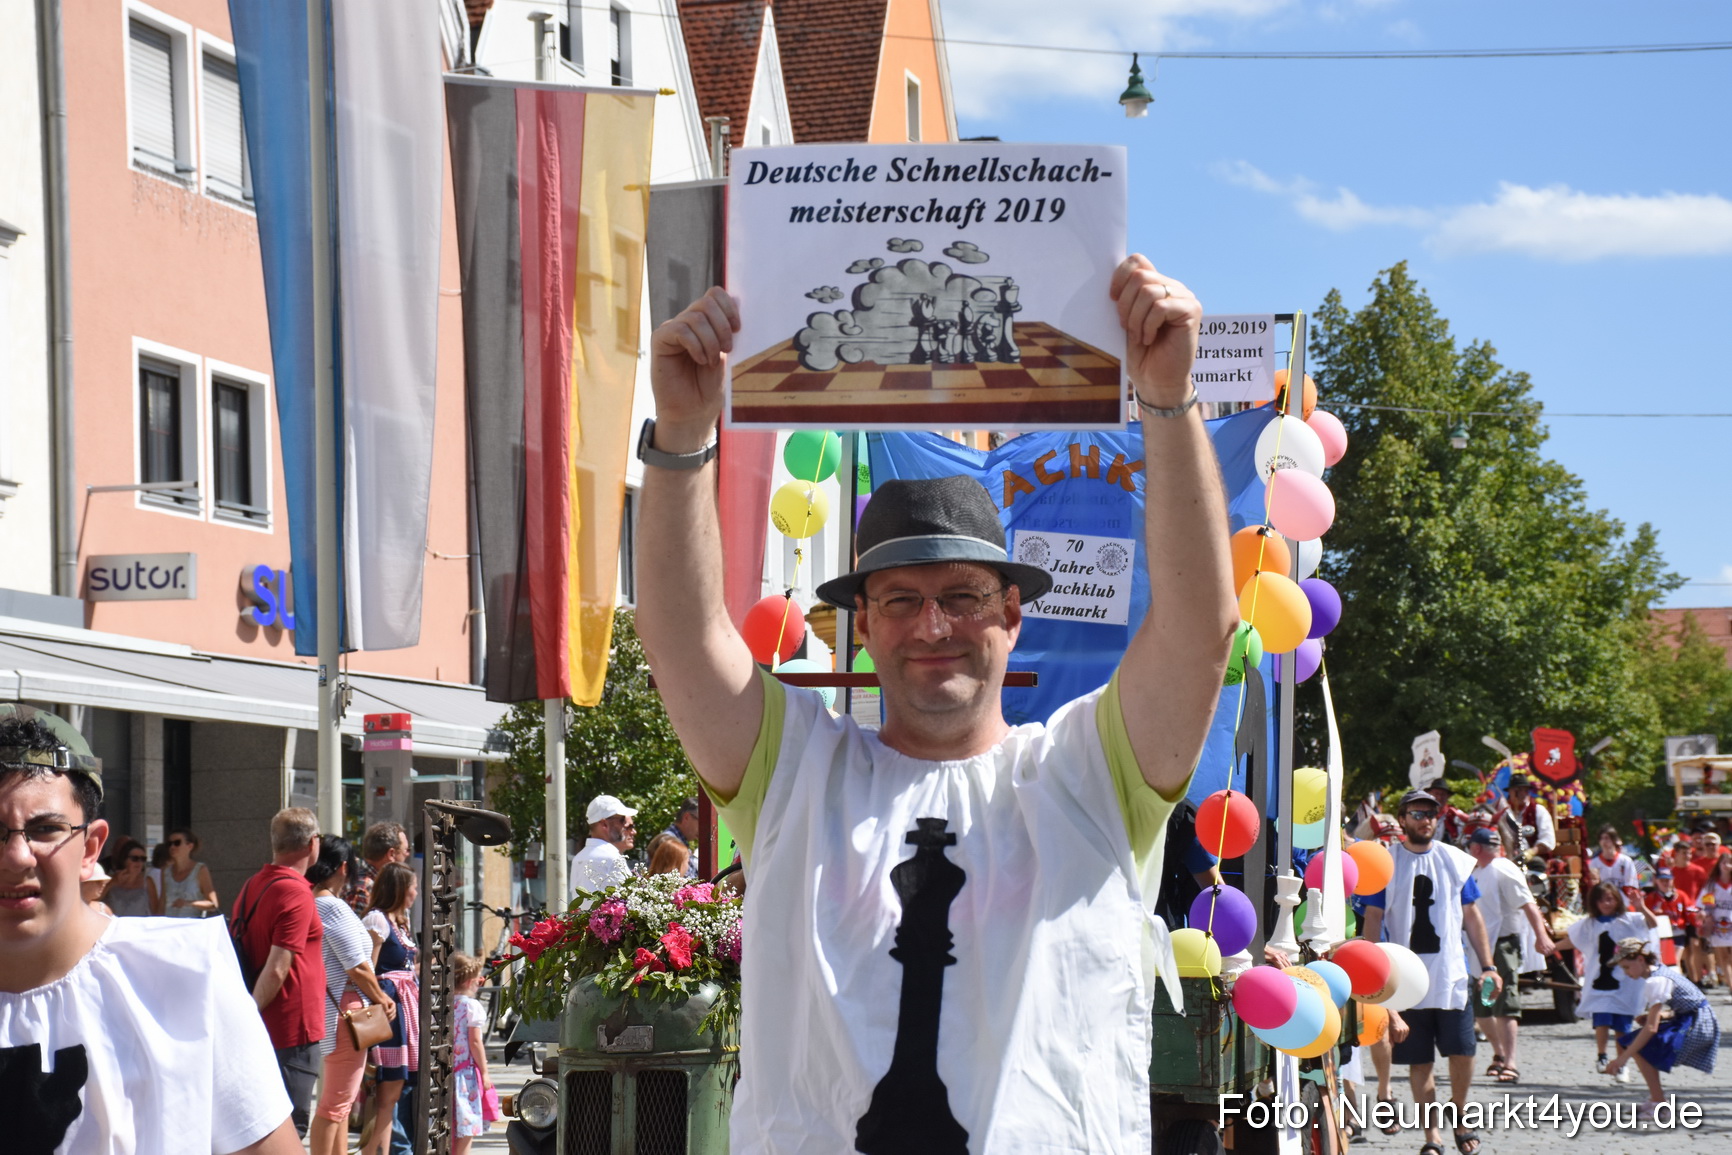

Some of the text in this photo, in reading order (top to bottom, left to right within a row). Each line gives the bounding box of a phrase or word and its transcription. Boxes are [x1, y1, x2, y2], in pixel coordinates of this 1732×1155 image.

[744, 157, 1112, 185] Deutsche Schnellschach-
[788, 197, 1066, 230] meisterschaft 2019
[1066, 539, 1084, 553] 70
[1050, 559, 1095, 576] Jahre
[1048, 582, 1116, 599] achklub
[1028, 600, 1108, 619] Neumarkt
